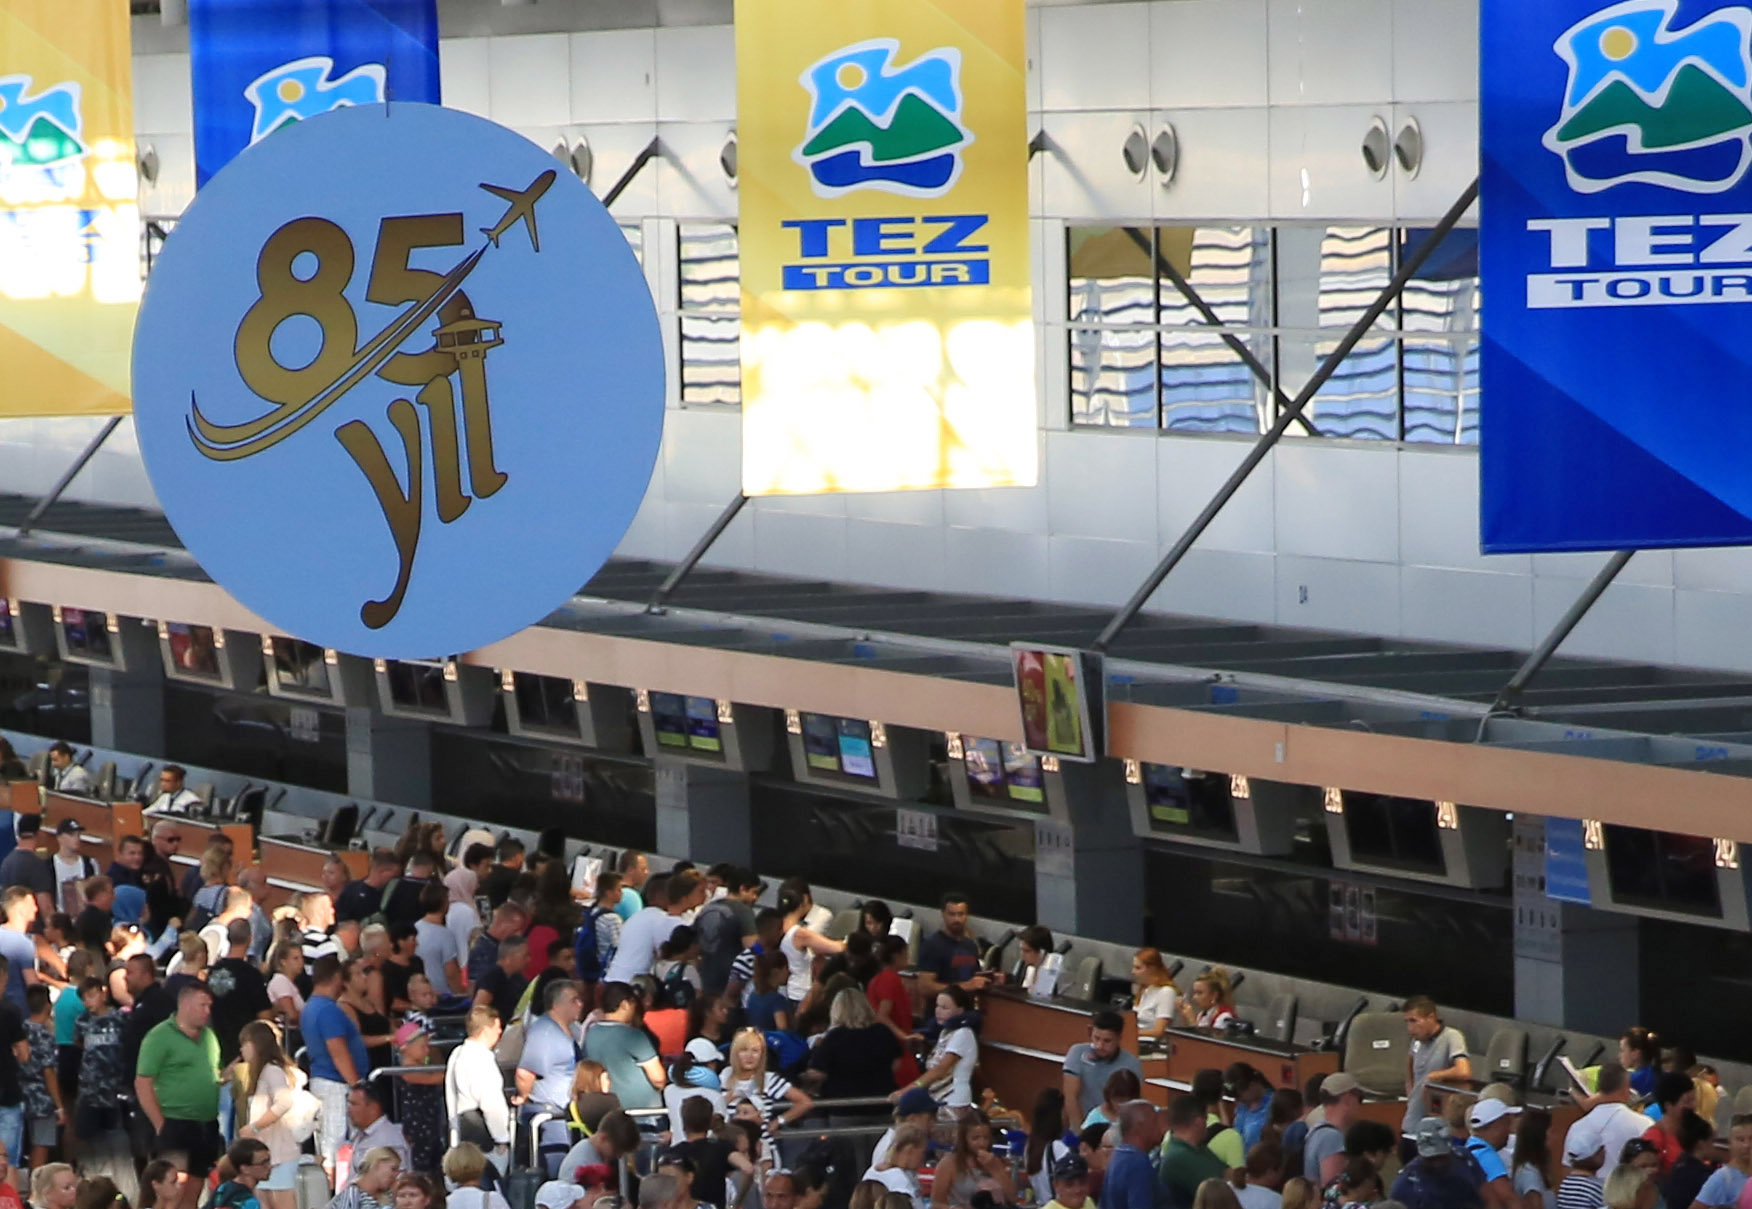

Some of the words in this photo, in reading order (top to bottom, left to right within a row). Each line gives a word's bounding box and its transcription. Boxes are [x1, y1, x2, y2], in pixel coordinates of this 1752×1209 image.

[781, 214, 989, 258] TEZ
[801, 262, 971, 288] TOUR
[234, 212, 476, 405] 85
[1713, 837, 1738, 869] 242
